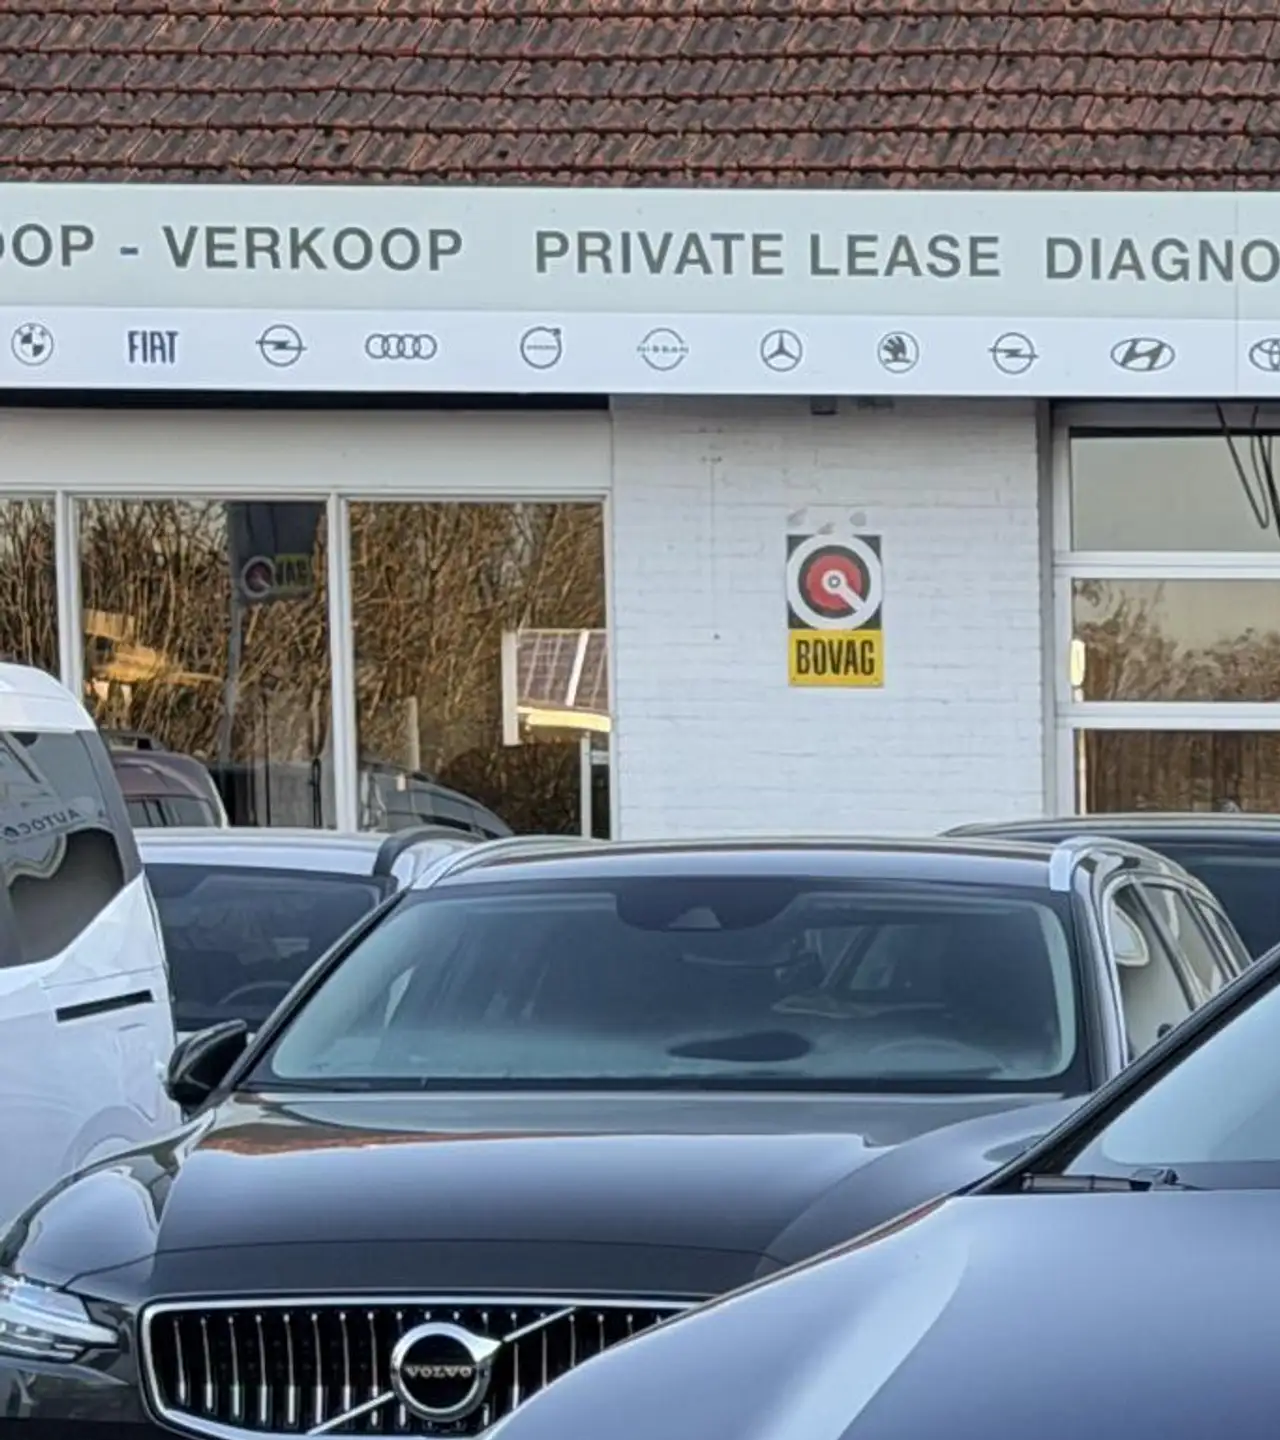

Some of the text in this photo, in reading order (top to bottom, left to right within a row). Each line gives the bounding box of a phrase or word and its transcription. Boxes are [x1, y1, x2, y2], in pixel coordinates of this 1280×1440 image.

[0, 222, 93, 267] OP
[162, 226, 462, 271] VERKOOP
[535, 231, 1000, 279] PRIVATE LEASE
[127, 331, 178, 364] FIAT
[796, 639, 875, 676] BOVAG
[404, 1365, 473, 1379] VOLVO
